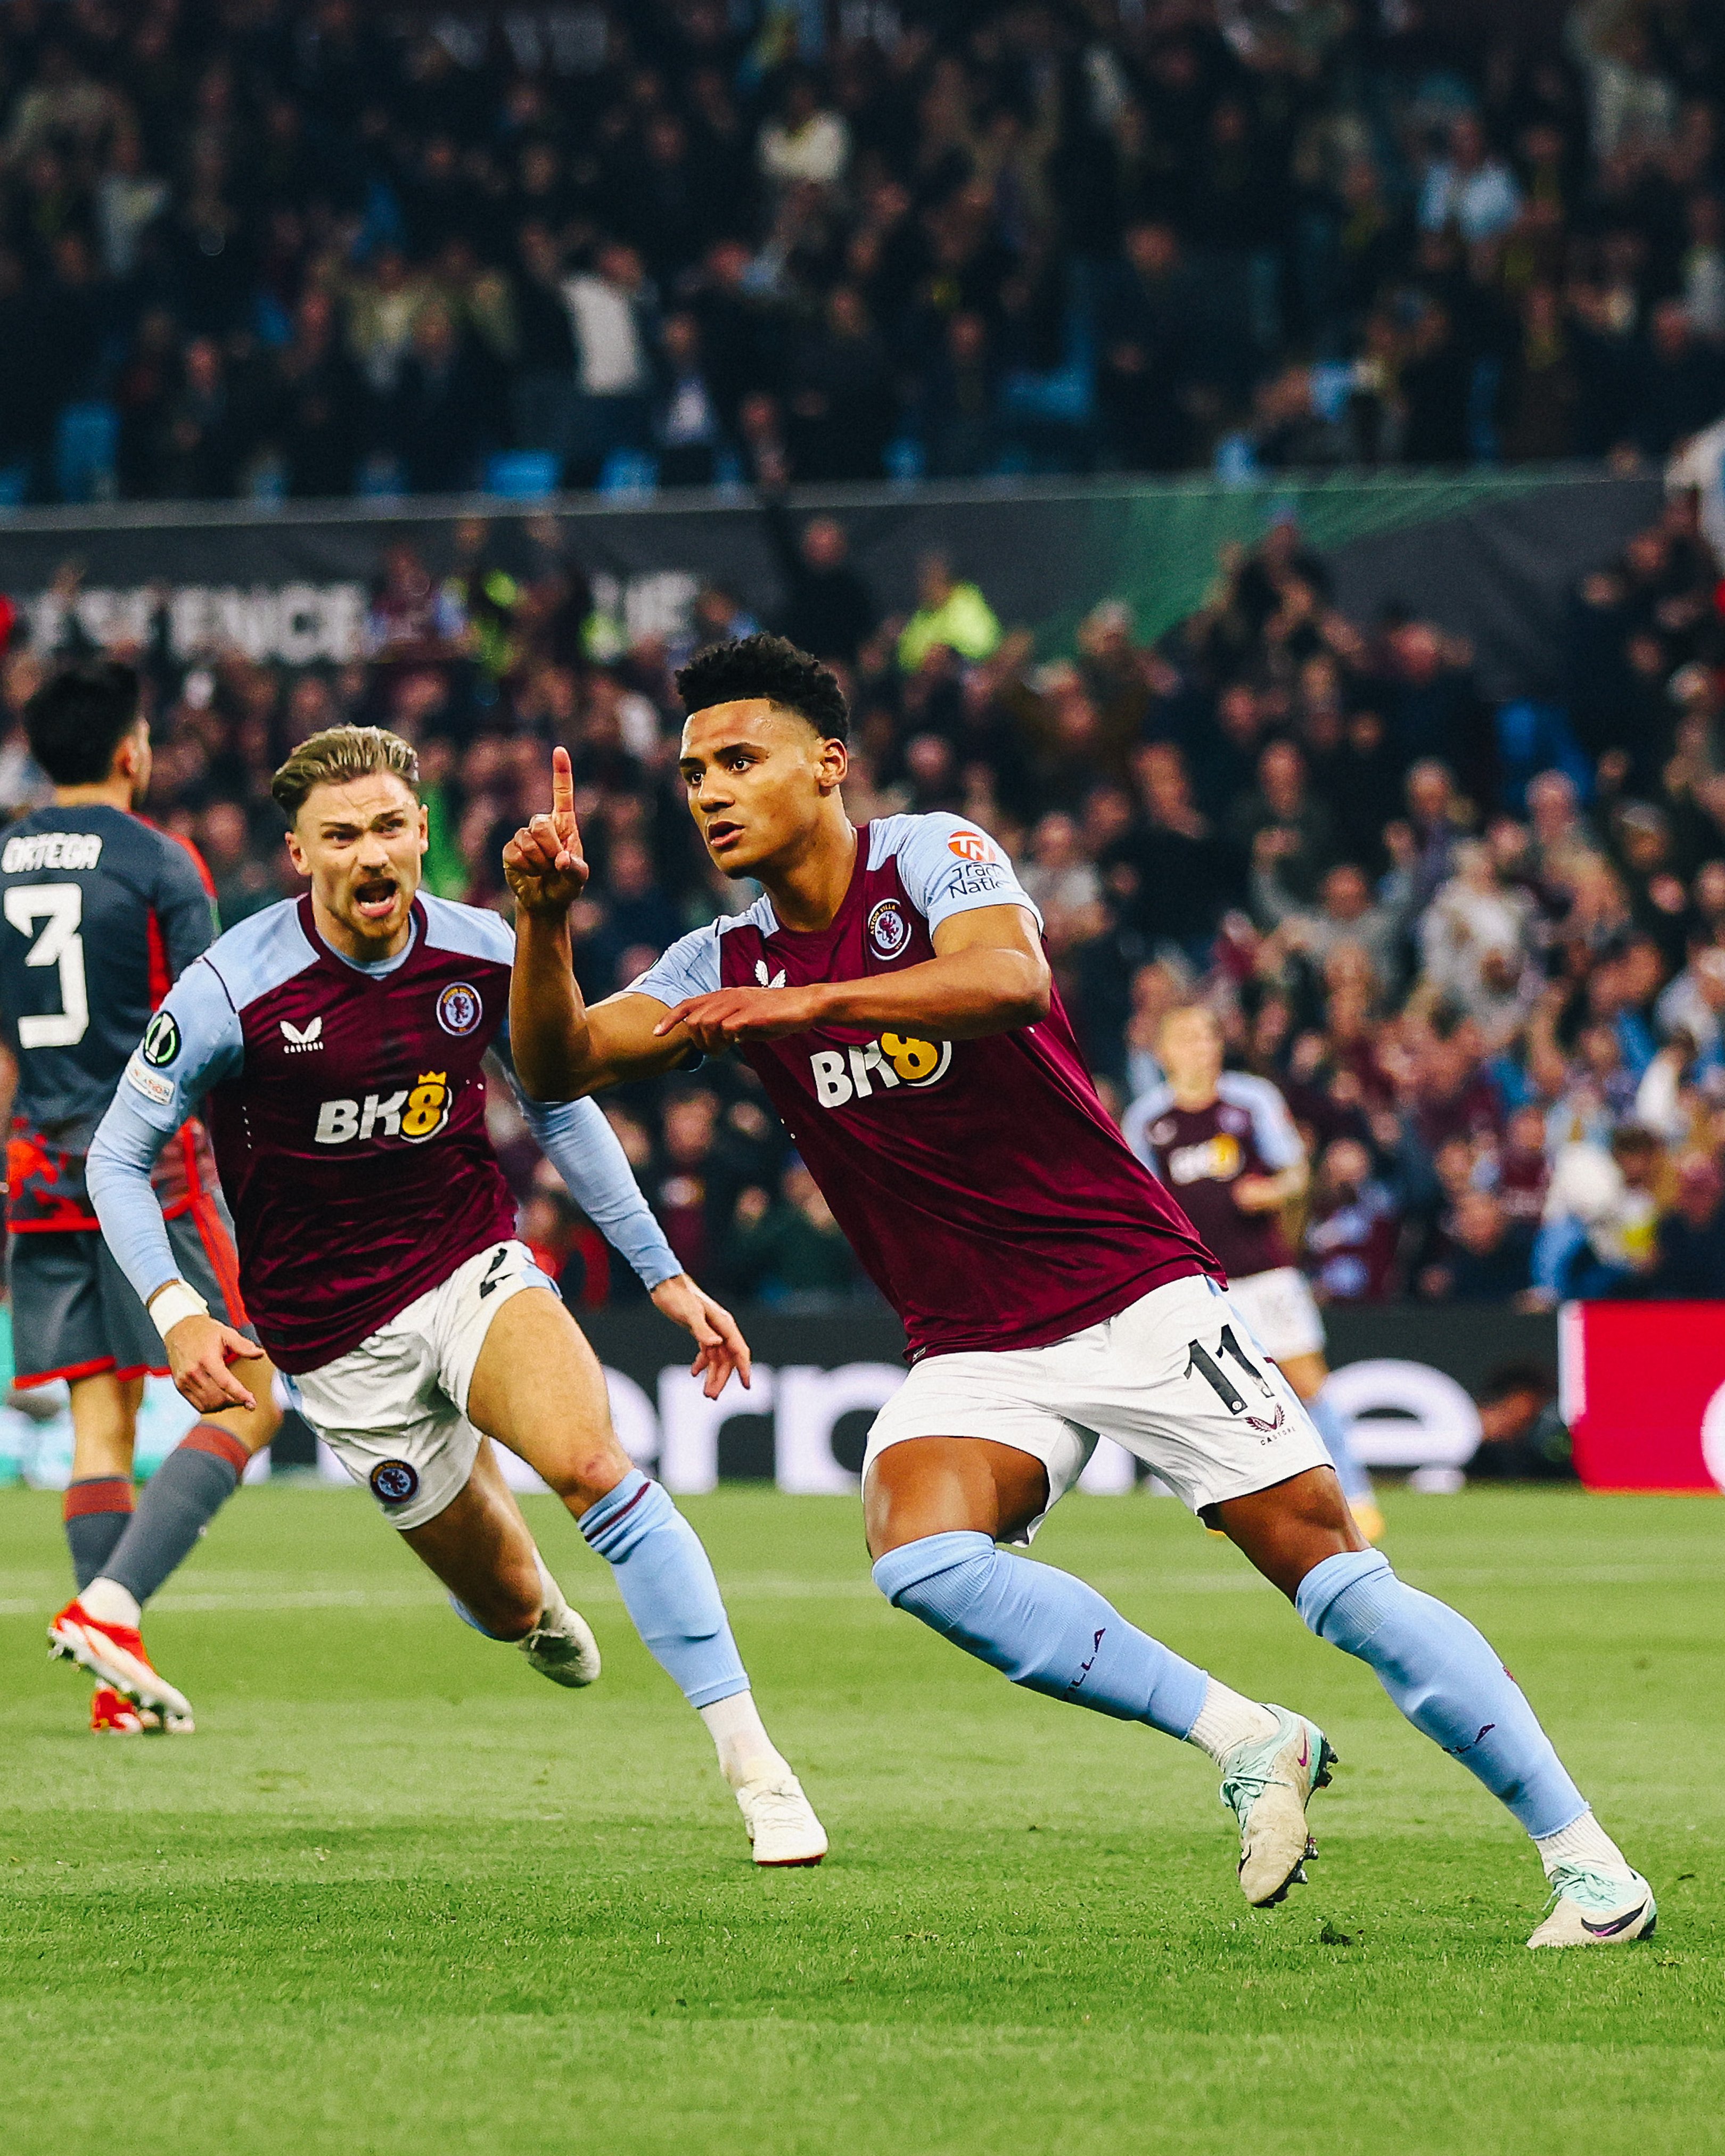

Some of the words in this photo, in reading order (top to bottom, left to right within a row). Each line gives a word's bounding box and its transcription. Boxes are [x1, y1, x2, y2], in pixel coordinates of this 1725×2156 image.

[2, 832, 103, 874] ORTEGA
[3, 882, 89, 1049] 3
[810, 1032, 951, 1108] BK8
[314, 1084, 453, 1144] BK8
[1183, 1323, 1275, 1416] 11
